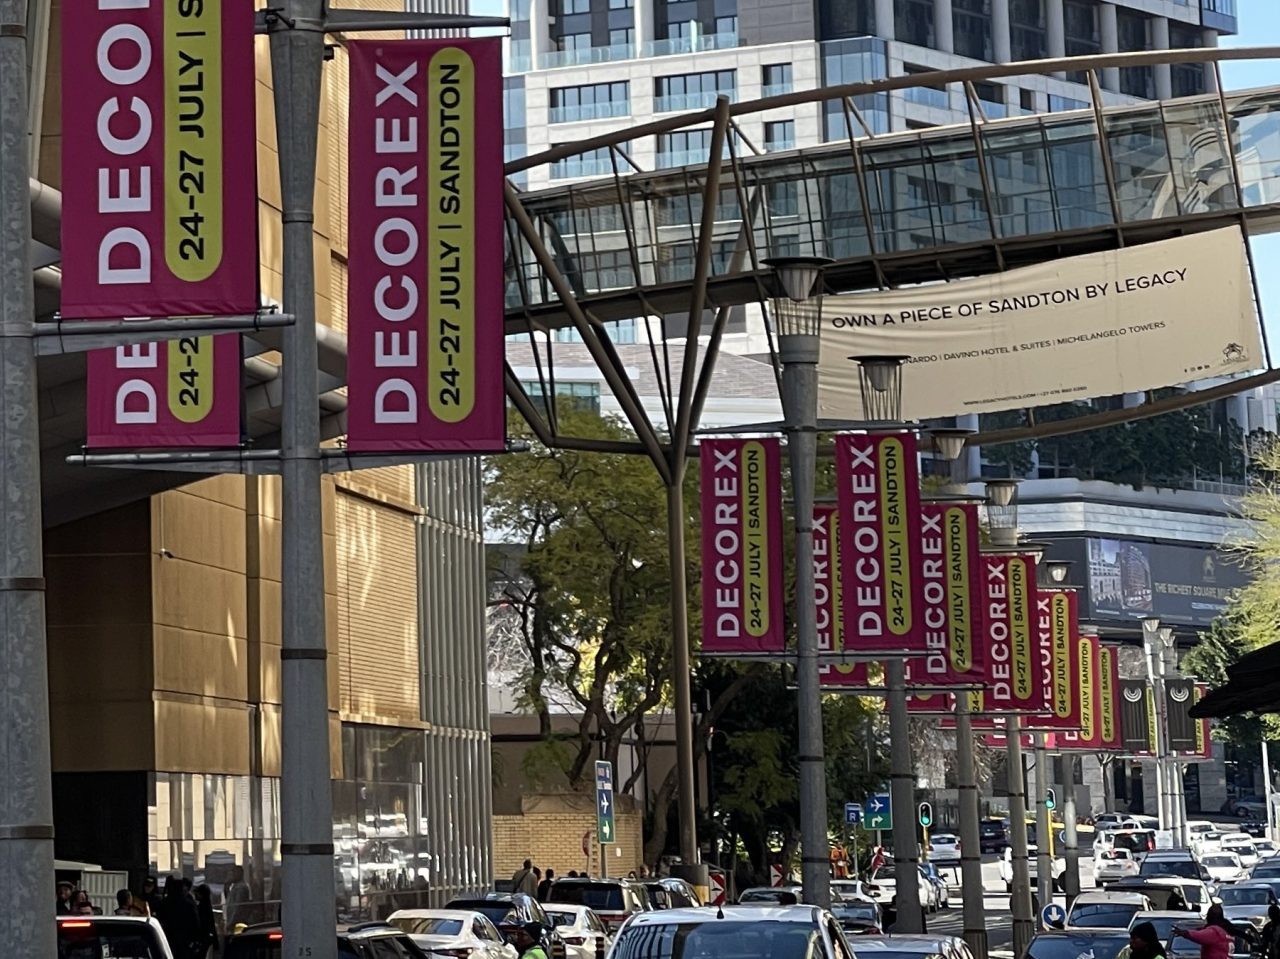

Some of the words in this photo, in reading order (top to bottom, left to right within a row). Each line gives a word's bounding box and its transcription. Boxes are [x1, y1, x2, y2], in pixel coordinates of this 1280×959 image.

[179, 51, 204, 138] JULY
[440, 65, 460, 214] SANDTON
[179, 150, 204, 260] 24-27
[375, 62, 418, 423] DECOREX
[440, 240, 460, 309] JULY
[833, 314, 877, 328] OWN
[883, 314, 895, 325] A
[901, 305, 952, 323] PIECE
[958, 302, 983, 317] OF
[989, 288, 1080, 314] SANDTON
[1087, 283, 1108, 299] BY
[1115, 268, 1187, 294] LEGACY
[440, 319, 459, 405] 24-27
[943, 350, 979, 360] DAVINCI
[981, 347, 1009, 356] HOTEL
[1020, 340, 1051, 351] SUITES
[1057, 328, 1127, 345] MICHELANGELO
[1128, 321, 1166, 333] TOWERS
[179, 337, 199, 406] 24-2
[747, 450, 759, 529] SANDTON
[885, 446, 899, 527] SANDTON
[714, 449, 740, 637] DECOREX
[748, 542, 761, 578] JULY
[851, 445, 882, 636] DECOREX
[888, 539, 902, 576] JULY
[950, 514, 962, 582] SANDTON
[751, 583, 761, 628] 24-27
[891, 581, 905, 626] 24-27
[921, 513, 946, 674] DECOREX
[952, 593, 964, 624] JULY
[1012, 564, 1023, 621] SANDTON
[955, 626, 965, 666] 24-27
[987, 563, 1011, 700] DECOREX
[1015, 632, 1026, 657] JULY
[1055, 599, 1064, 649] SANDTON
[1018, 659, 1027, 693] 24-27
[1057, 658, 1065, 681] JULY
[1058, 685, 1066, 712] 24-27
[1081, 691, 1089, 710] JULY
